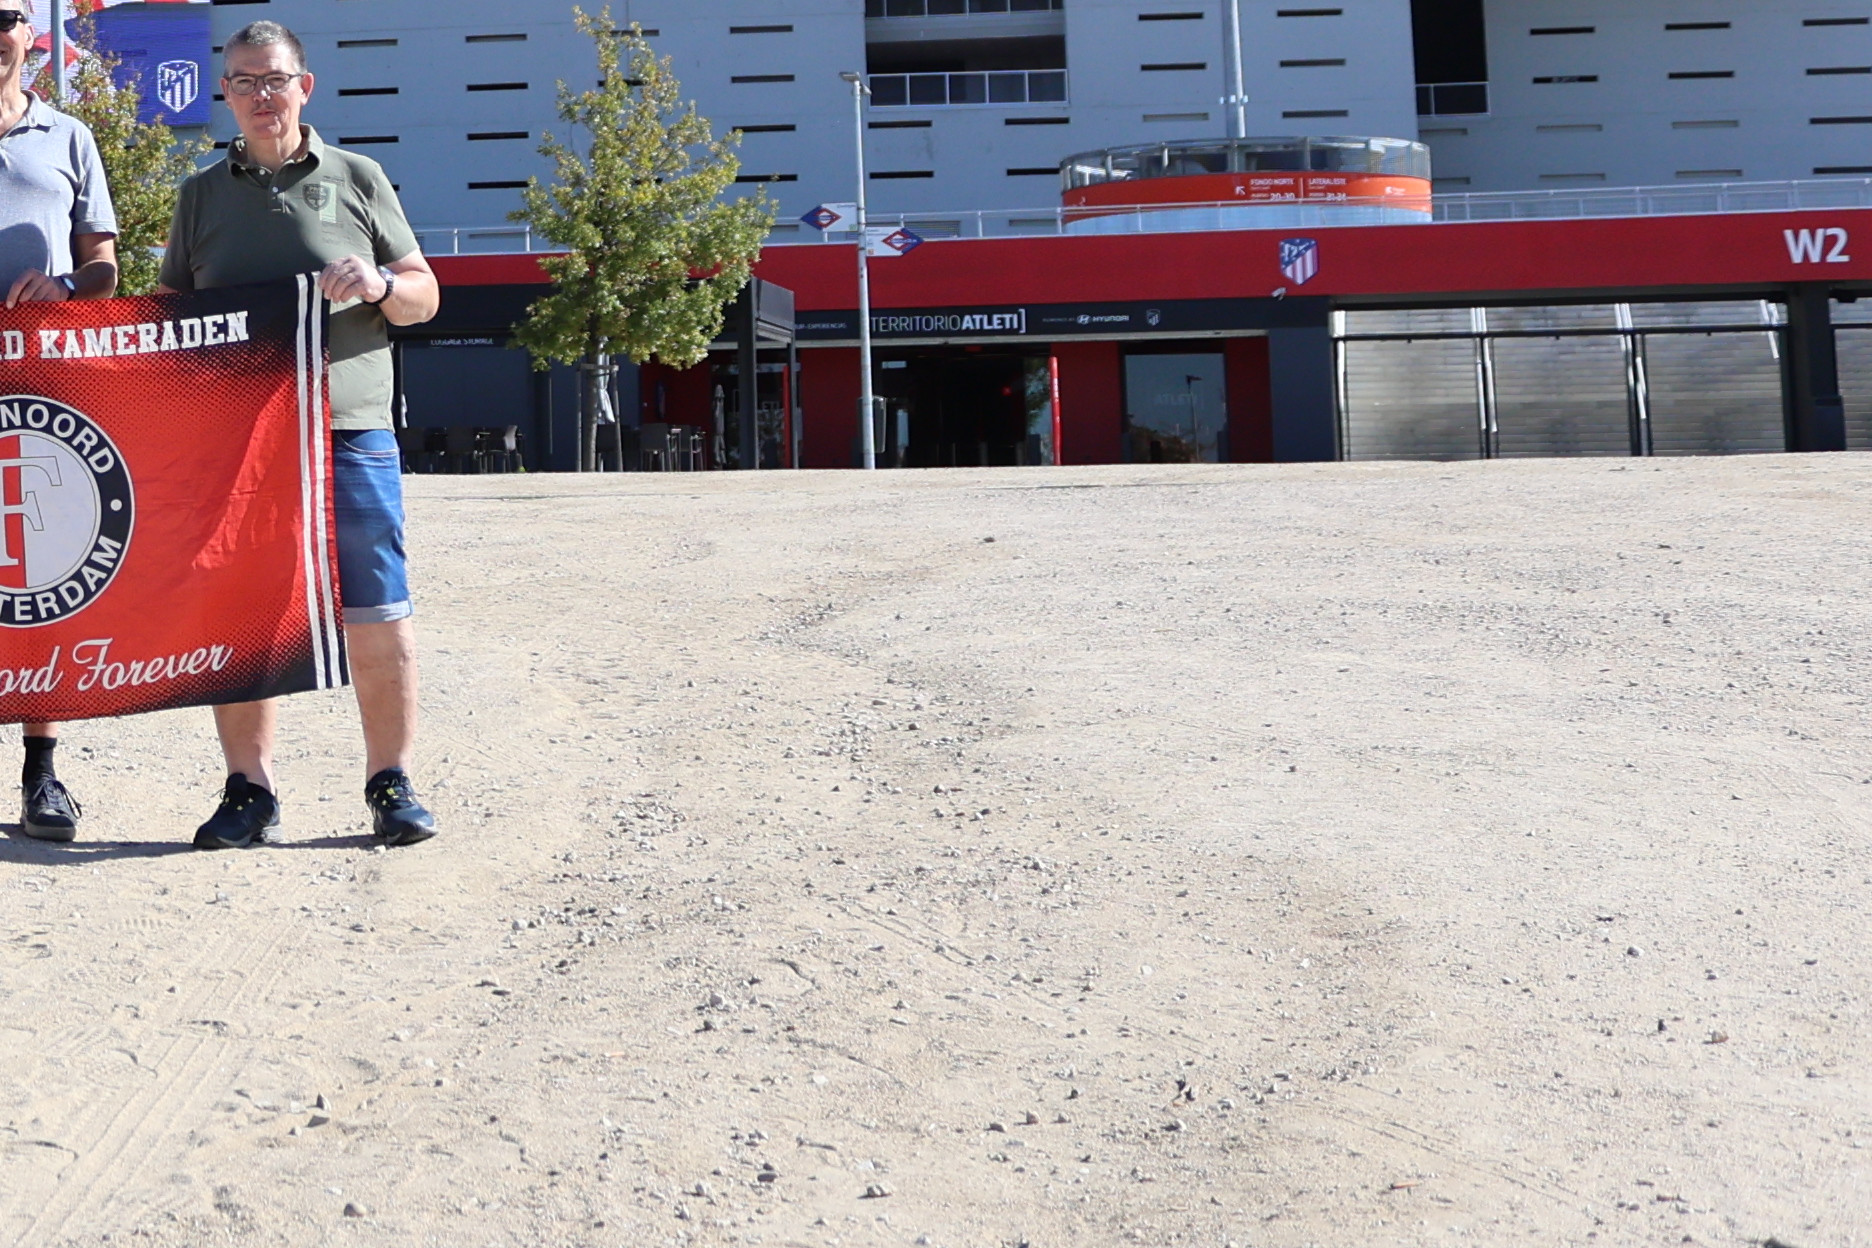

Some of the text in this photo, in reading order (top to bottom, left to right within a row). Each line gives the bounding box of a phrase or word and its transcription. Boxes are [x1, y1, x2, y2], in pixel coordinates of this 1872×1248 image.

[1783, 227, 1851, 264] W2
[38, 310, 250, 360] KAMERADEN
[72, 637, 234, 692] Forever
